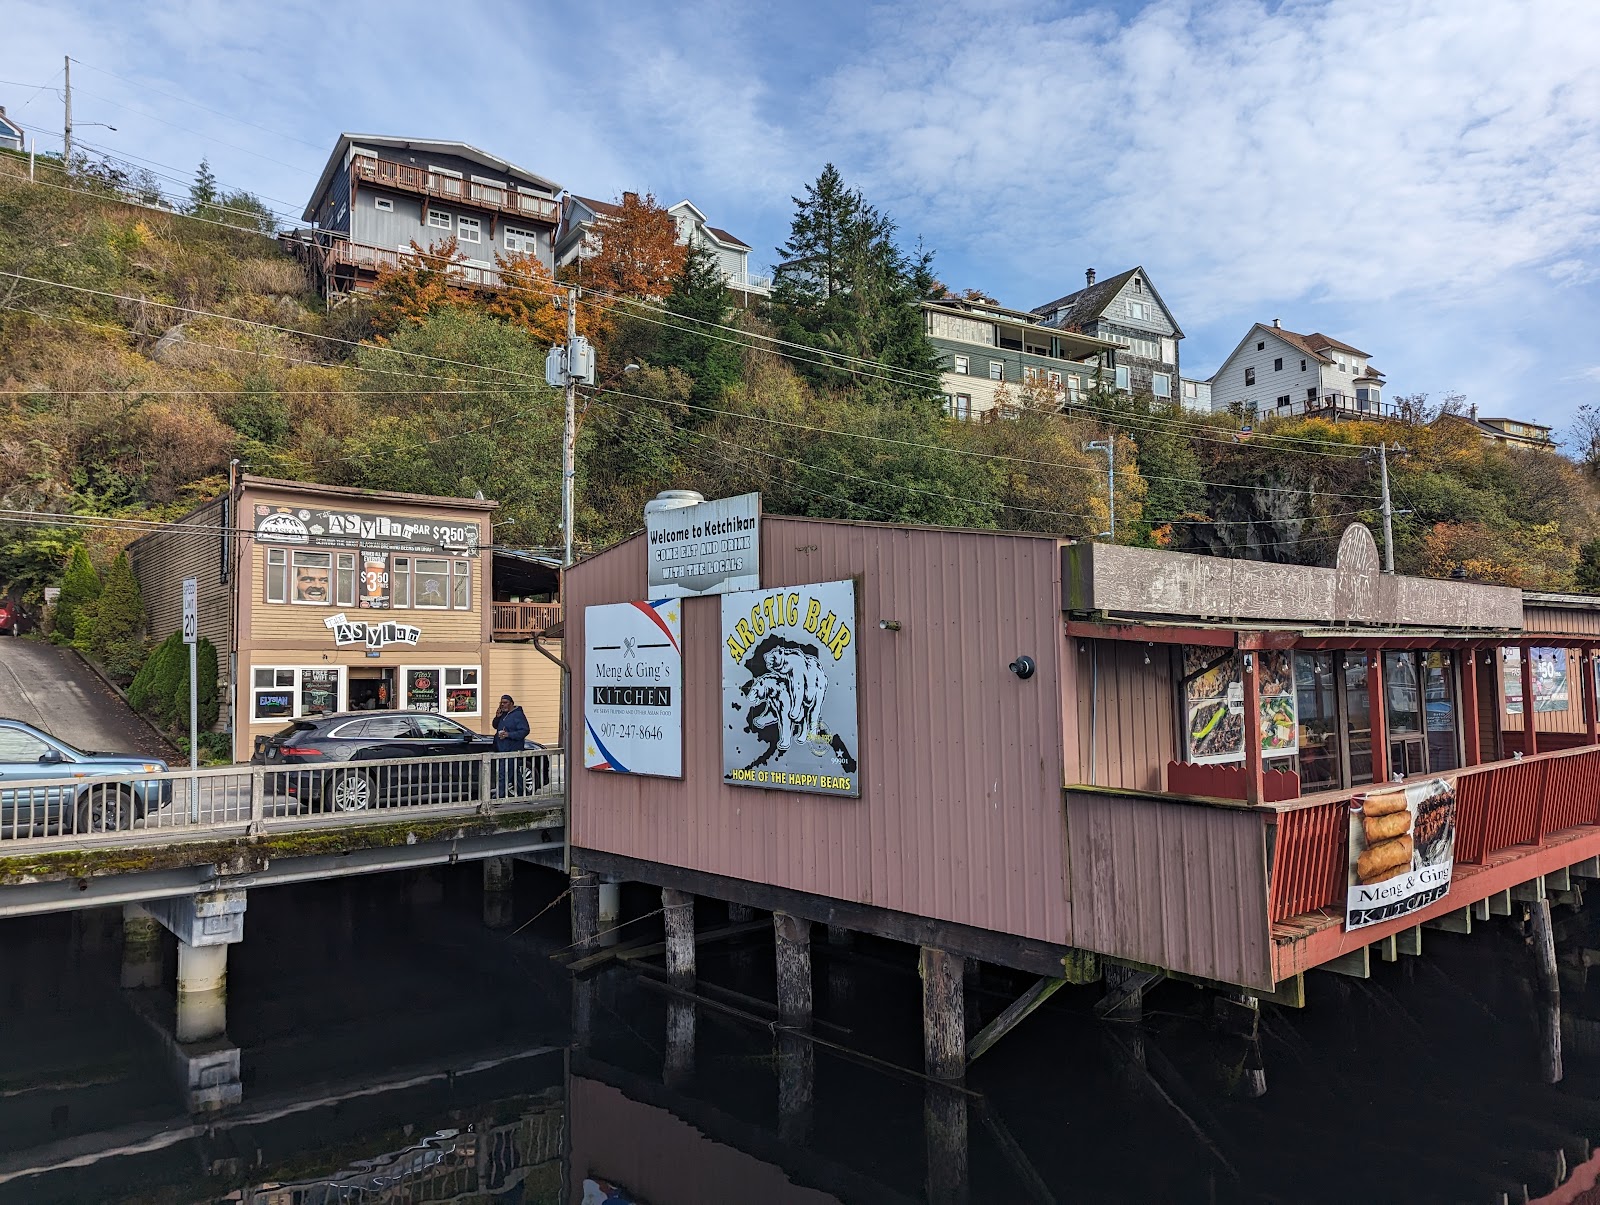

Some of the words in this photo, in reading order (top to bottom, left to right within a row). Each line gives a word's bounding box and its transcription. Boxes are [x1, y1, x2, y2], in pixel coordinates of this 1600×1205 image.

[413, 524, 430, 536] BAR
[650, 529, 689, 545] Welcome
[692, 524, 702, 539] to
[704, 515, 756, 537] Ketchikan
[655, 547, 679, 561] COME
[681, 543, 698, 558] EAT
[701, 540, 719, 555] AND
[721, 535, 751, 552] DRINK
[662, 565, 685, 579] WITH
[687, 562, 705, 576] THE
[708, 557, 743, 574] LOCALS
[185, 614, 194, 637] 20
[726, 592, 800, 665] ARCTIC
[803, 596, 852, 661] BAR
[596, 663, 622, 681] Meng
[624, 662, 633, 678] &
[636, 661, 670, 681] Ging's
[260, 696, 288, 706] ELYSIAN
[596, 688, 668, 705] KITCHEN
[660, 709, 671, 717] FOOD
[601, 722, 663, 741] 907-247-8646
[732, 769, 756, 781] HOME
[758, 770, 769, 782] OF
[770, 771, 787, 784] THE
[789, 773, 818, 787] HAPPY
[820, 776, 851, 790] BEARS
[1357, 883, 1403, 903] Meng
[1406, 876, 1415, 890] &
[1419, 867, 1449, 884] Ging
